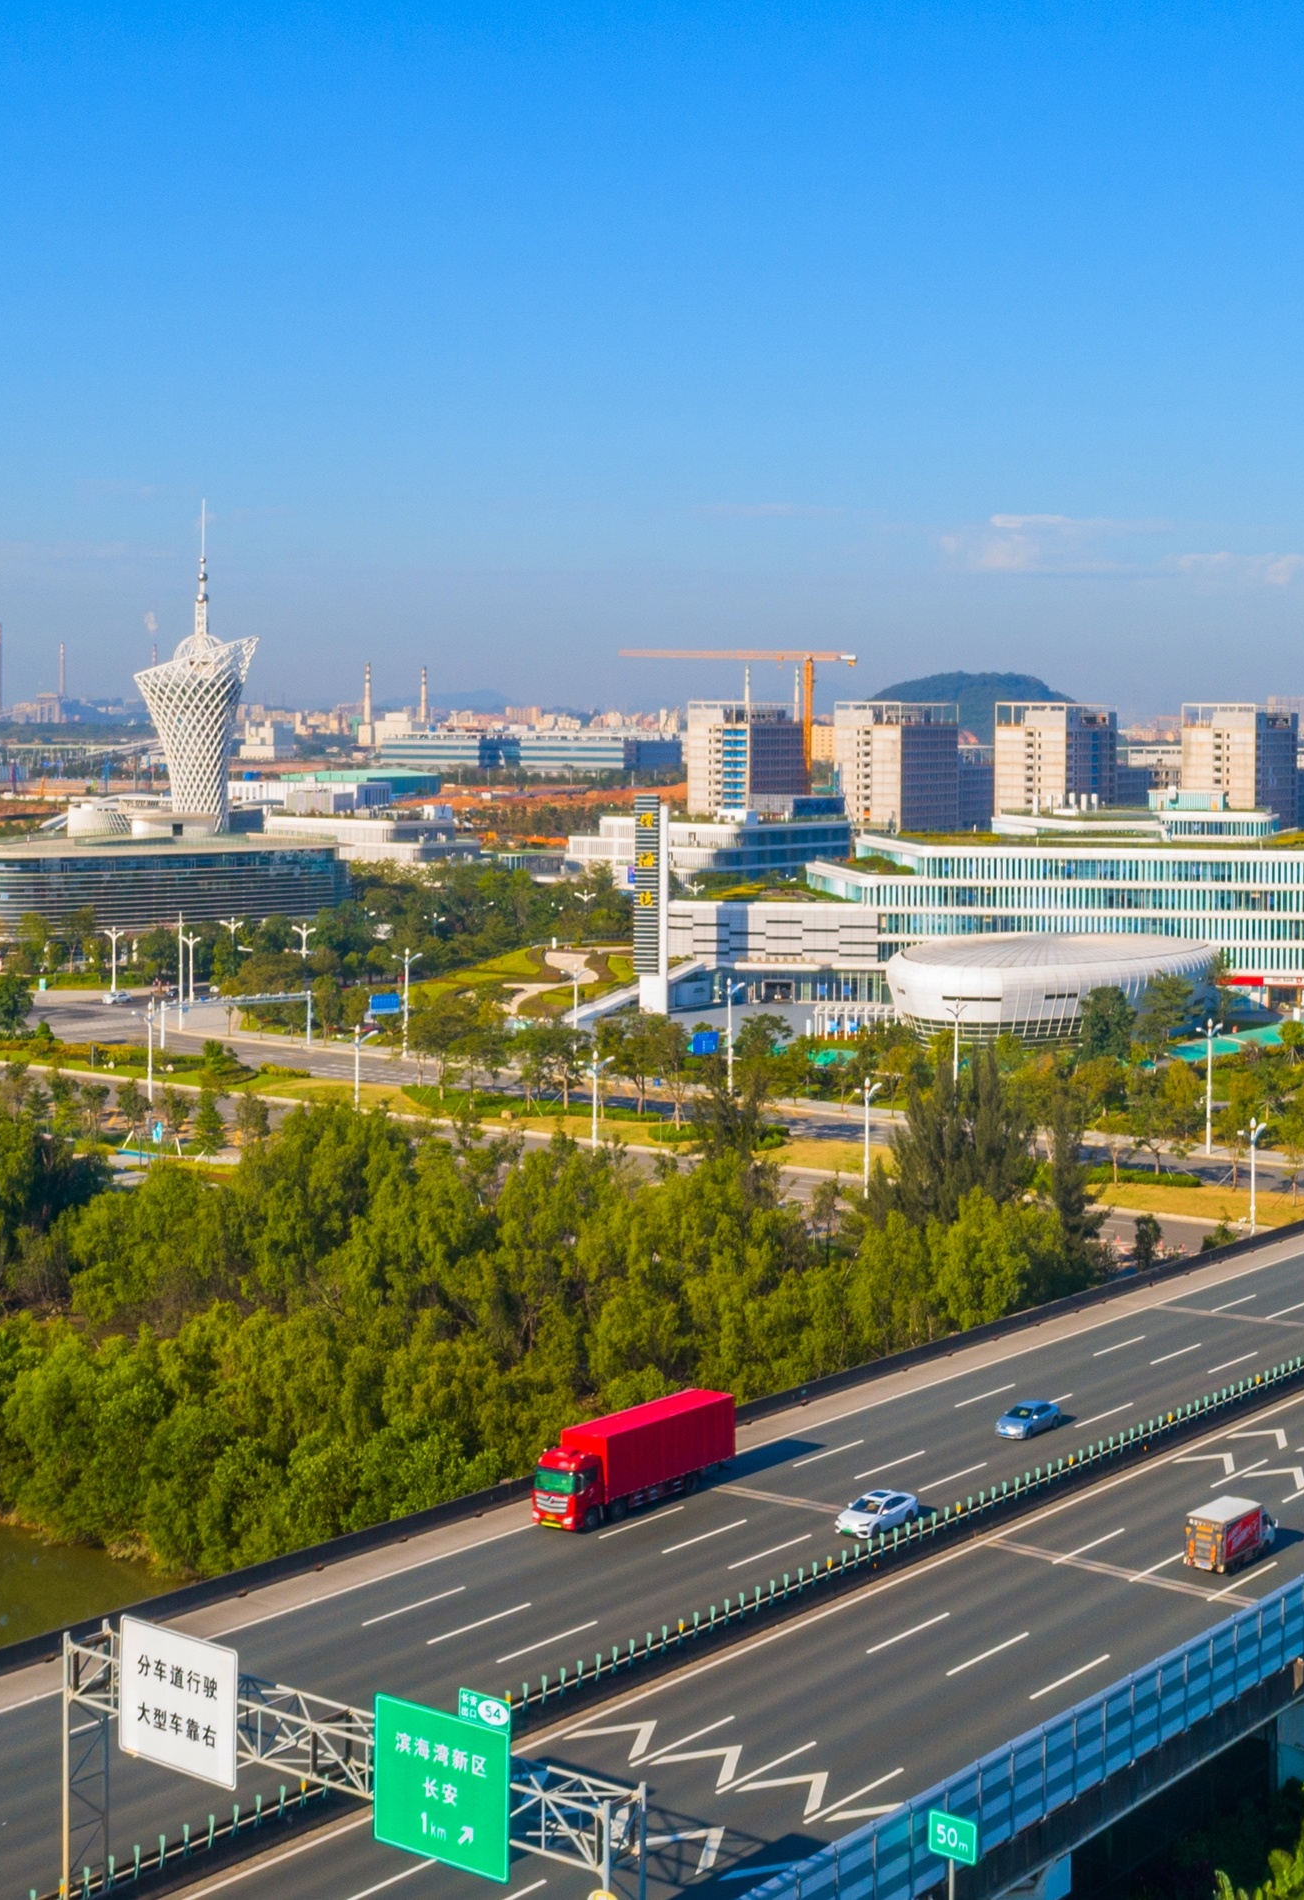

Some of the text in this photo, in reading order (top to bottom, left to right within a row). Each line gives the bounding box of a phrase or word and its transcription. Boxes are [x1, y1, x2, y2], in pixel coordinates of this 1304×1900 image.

[137, 1654, 218, 1701] 分车道行驶
[137, 1702, 217, 1749] 大型车靠右
[485, 1704, 502, 1720] 54
[395, 1732, 487, 1778] 滨海湾新区
[423, 1776, 458, 1807] 长安
